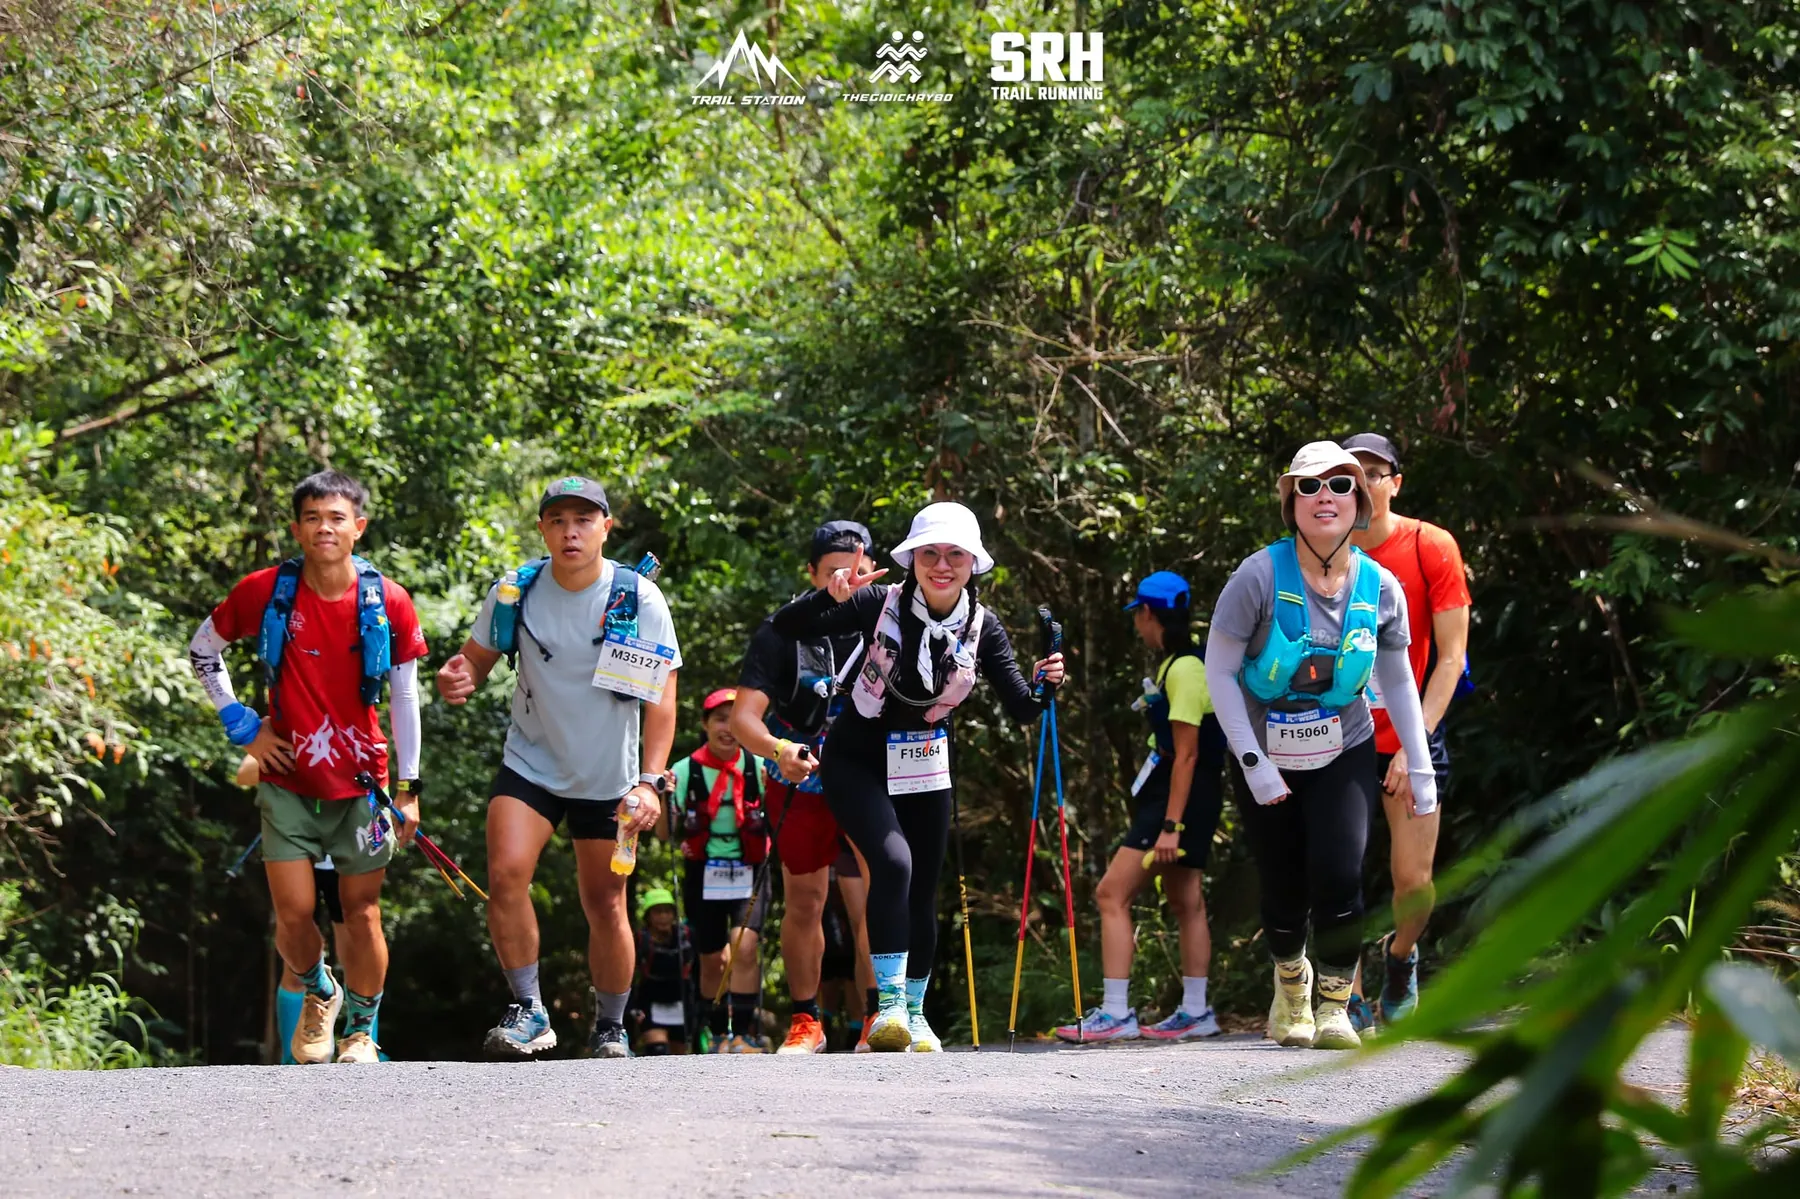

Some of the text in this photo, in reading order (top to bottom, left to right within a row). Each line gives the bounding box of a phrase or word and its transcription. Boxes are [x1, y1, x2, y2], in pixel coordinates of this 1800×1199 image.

[611, 648, 661, 670] M35127
[1280, 724, 1329, 739] F15060
[900, 744, 940, 760] F15064
